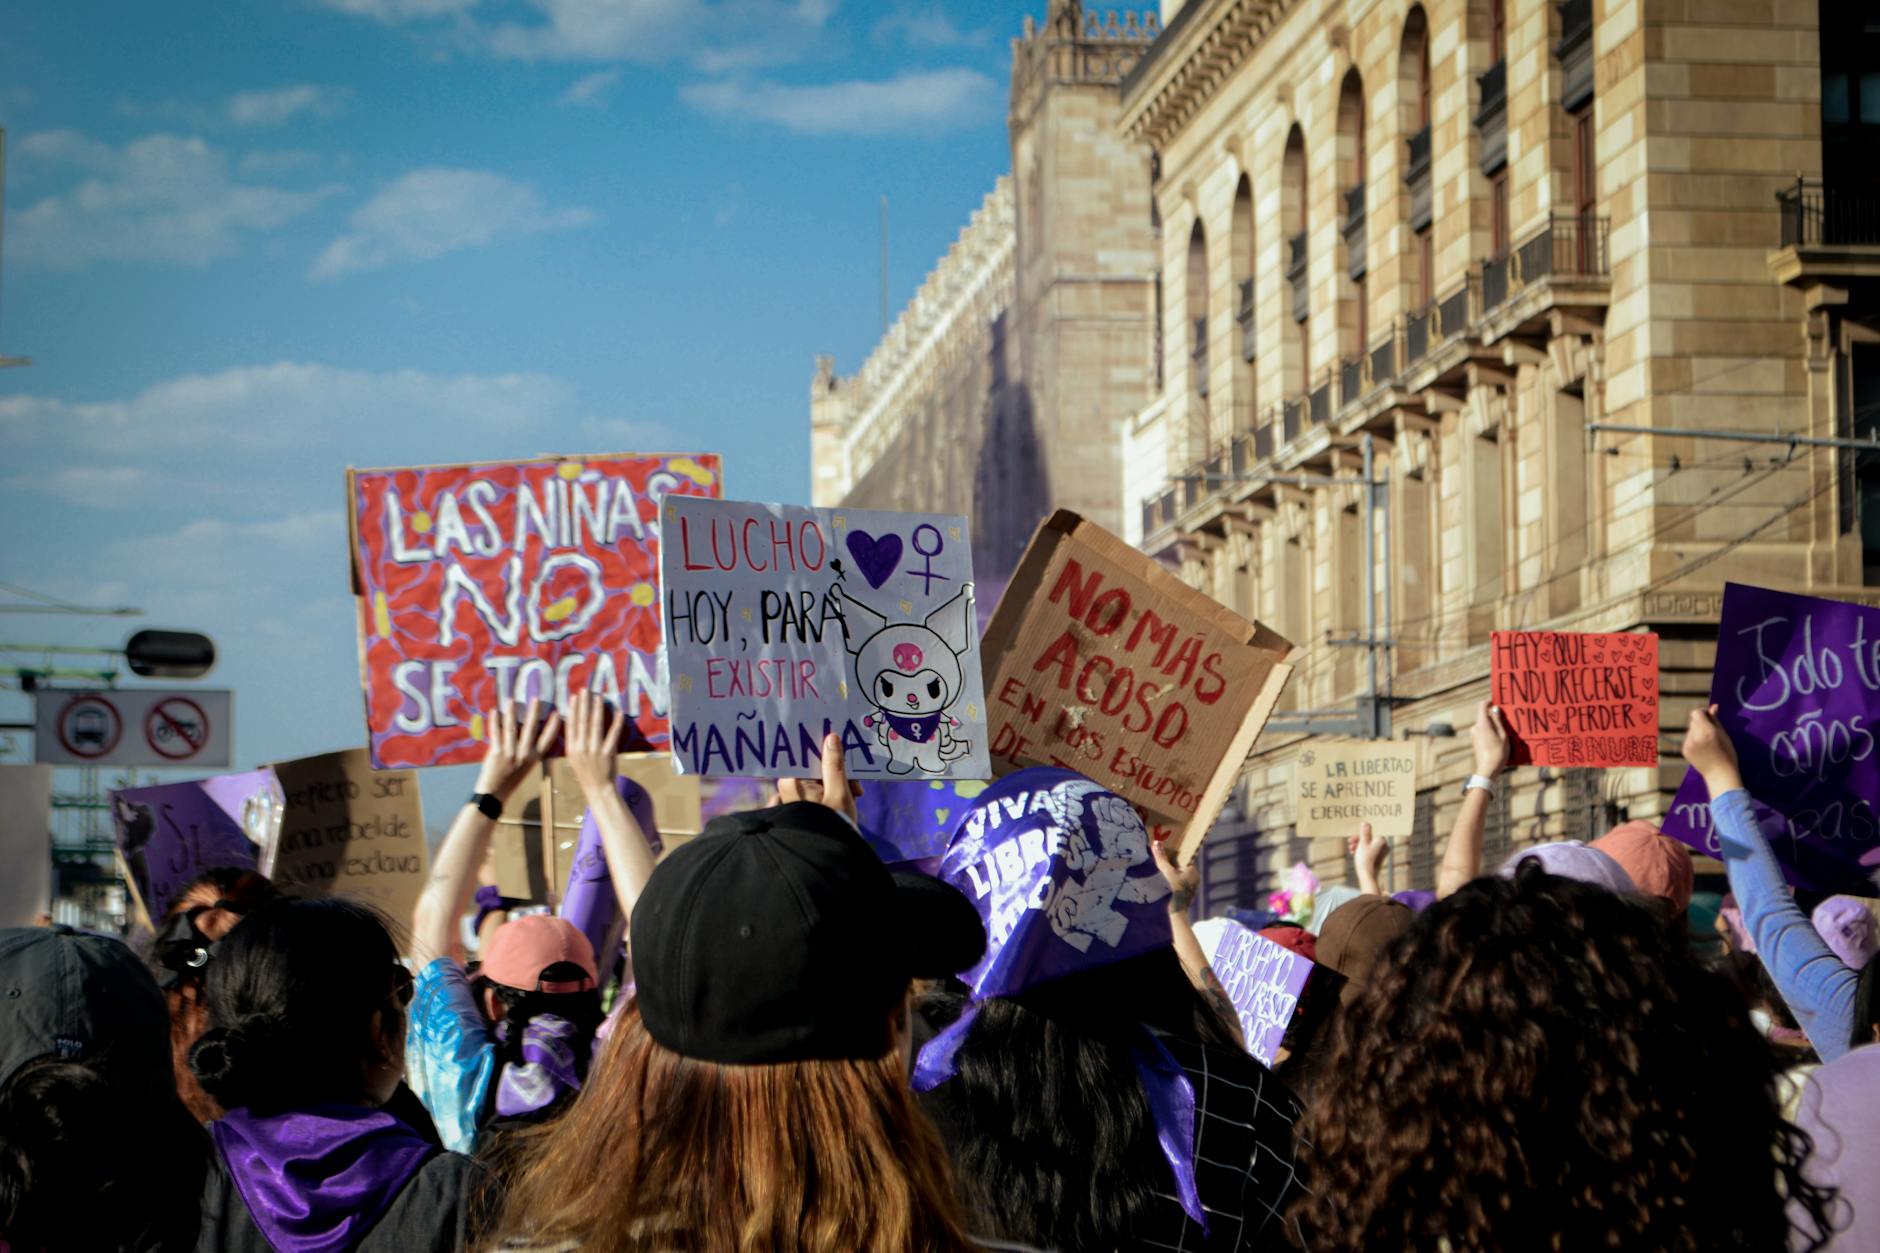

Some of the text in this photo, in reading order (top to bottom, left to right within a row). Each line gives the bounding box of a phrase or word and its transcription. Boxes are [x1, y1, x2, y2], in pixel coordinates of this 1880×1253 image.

[387, 472, 678, 563] LAS NIÑAS
[681, 516, 825, 572] LUCHO
[440, 554, 605, 647] NO
[761, 590, 851, 644] PARA
[1049, 559, 1227, 705] NO MÁS
[1497, 632, 1590, 669] HAY QUE
[392, 648, 668, 733] SE TOCAN
[706, 658, 820, 700] EXISTIR
[1033, 631, 1188, 748] ACOSO
[673, 710, 875, 775] MAÑANA
[998, 677, 1045, 723] EN
[1054, 710, 1105, 760] LOS
[1514, 704, 1635, 735] SIN PERDER
[992, 722, 1033, 769] DE
[1326, 757, 1414, 778] LA LIBERTAD
[1525, 735, 1659, 765] TERNURA
[1771, 708, 1875, 784] años
[372, 776, 408, 799] ser
[1301, 780, 1396, 800] SE APRENDE
[1311, 803, 1402, 820] EJERCIENDOLA
[344, 851, 420, 877] esclava
